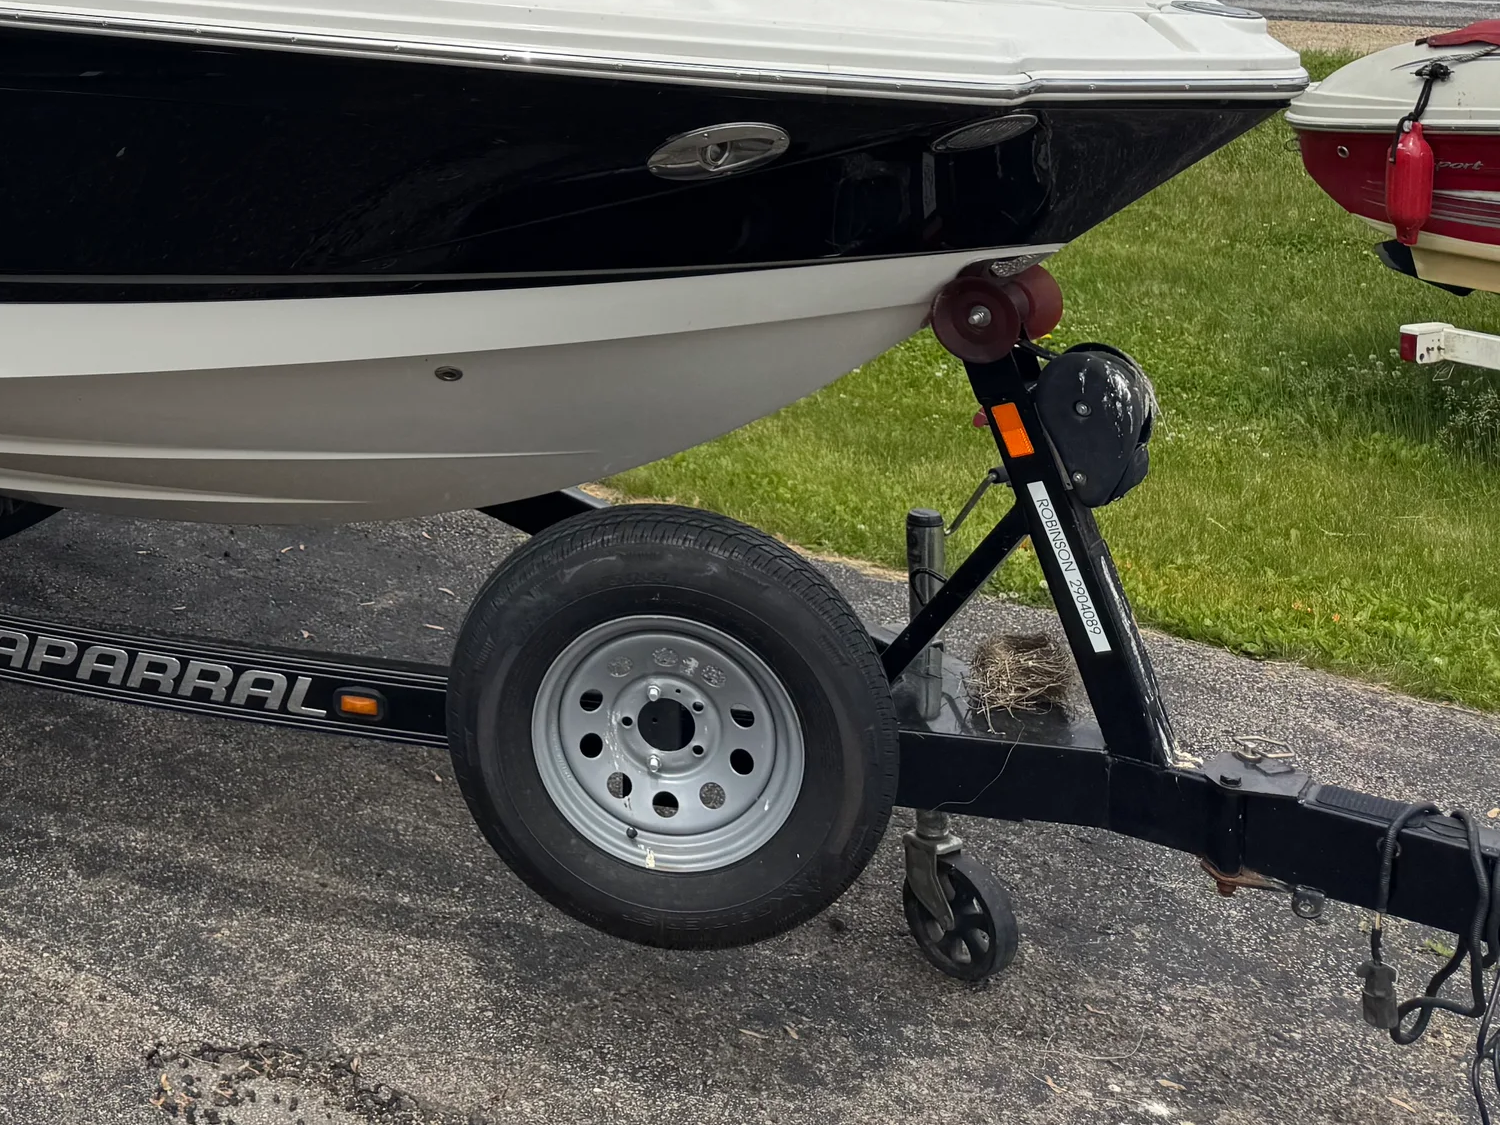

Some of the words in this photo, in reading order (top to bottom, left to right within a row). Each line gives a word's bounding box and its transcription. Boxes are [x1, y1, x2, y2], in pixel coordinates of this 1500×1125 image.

[1434, 158, 1484, 172] port
[1036, 498, 1076, 572] ROBINSON
[1069, 579, 1102, 635] 2904089
